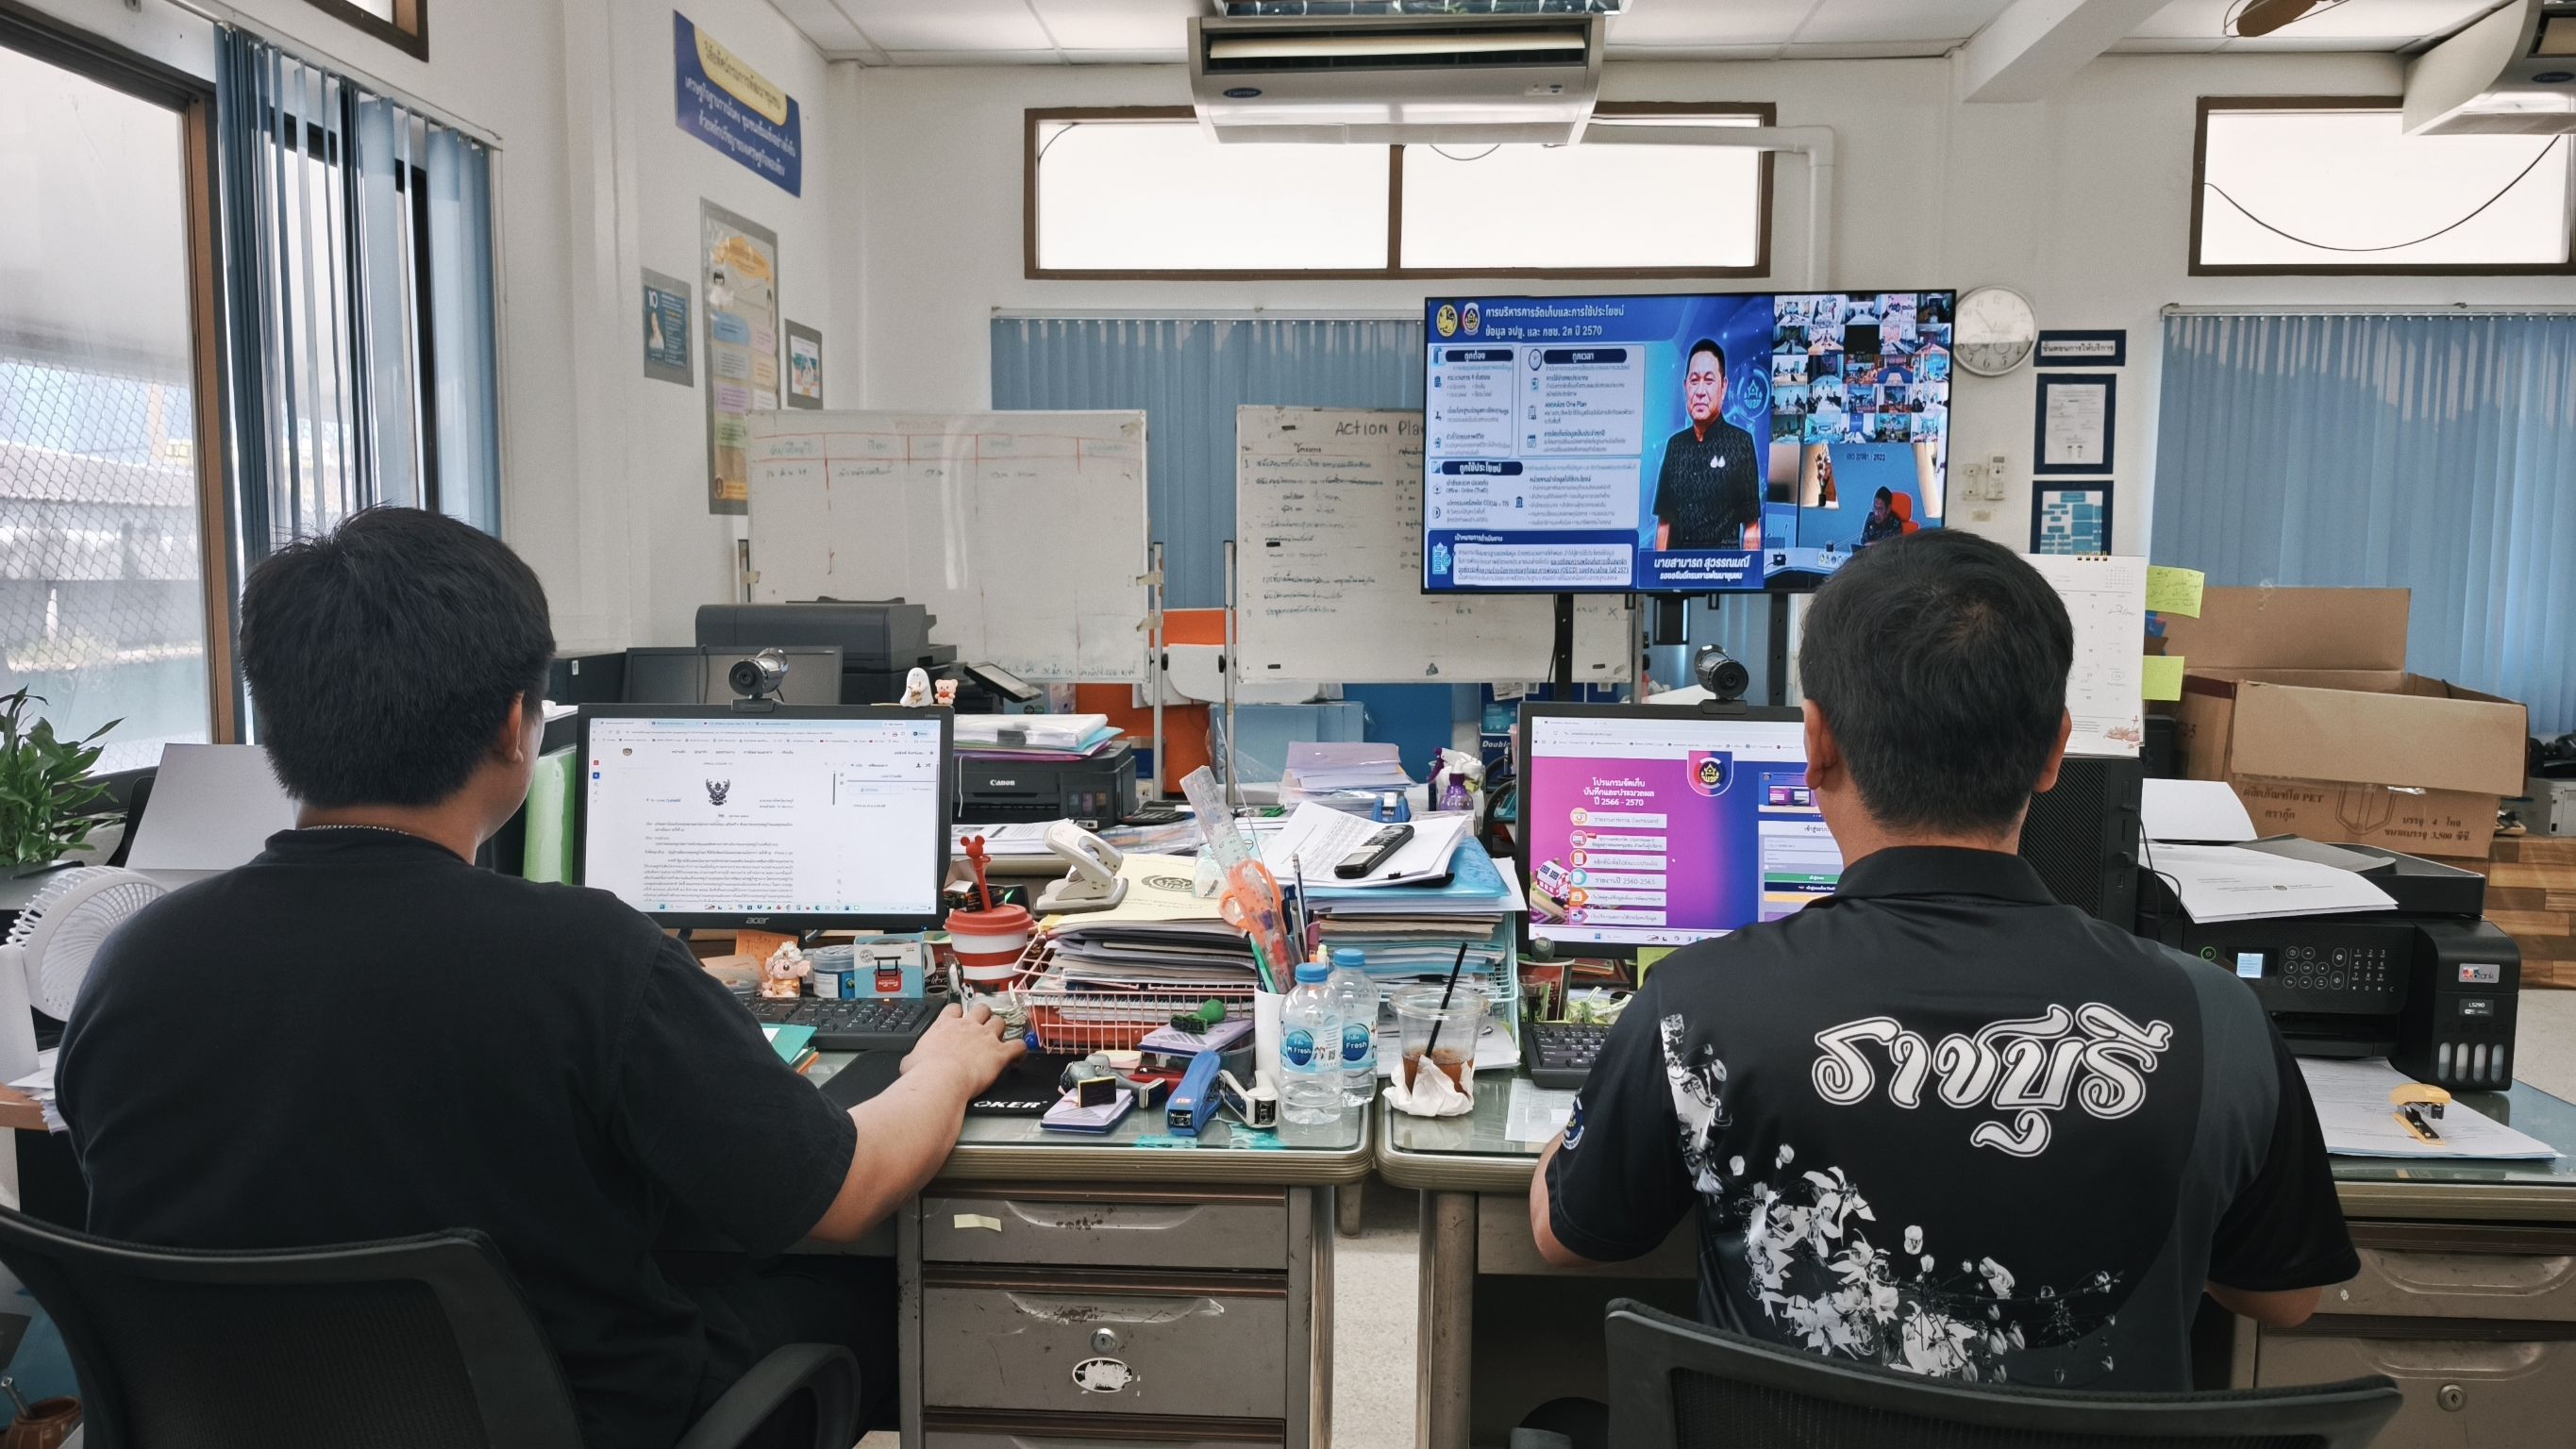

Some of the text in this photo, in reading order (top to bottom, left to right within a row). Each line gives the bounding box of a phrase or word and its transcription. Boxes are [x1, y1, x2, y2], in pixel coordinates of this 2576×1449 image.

[1486, 304, 1624, 318] การบริหารการจัดเก็บและการใช้ประโยชน์
[1486, 324, 1506, 340] ข้อมูล
[1528, 327, 1540, 338] และ
[1575, 325, 1581, 337] ปี
[1582, 325, 1602, 337] 2570
[1464, 350, 1486, 362] ถูกต้อง
[1459, 461, 1502, 475] ถูกใช้ประโยชน์
[1654, 557, 1702, 568] นายสามารถ
[1593, 777, 1646, 787] โปรแกรมจัดเก็บ
[1594, 796, 1599, 806] ปี
[2302, 793, 2324, 803] PET
[2402, 816, 2424, 827] บรรจุ
[1294, 1046, 1312, 1055] Fresh
[1812, 1003, 2173, 1158] ราชบุรี
